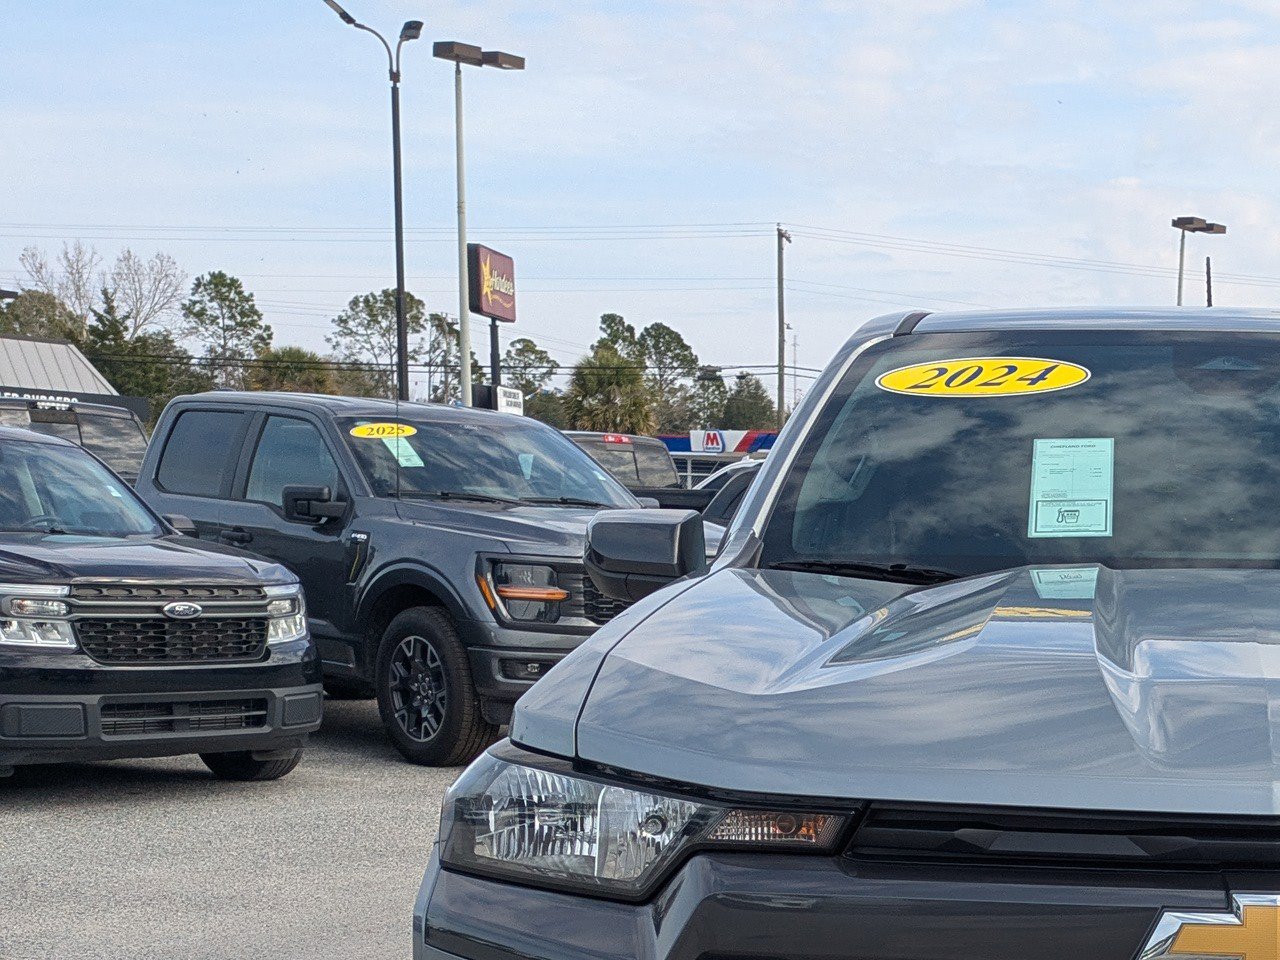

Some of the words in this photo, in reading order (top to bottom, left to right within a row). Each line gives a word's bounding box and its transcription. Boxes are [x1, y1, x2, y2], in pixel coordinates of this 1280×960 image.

[904, 364, 1061, 390] 2024
[366, 426, 406, 436] 2025
[705, 432, 720, 446] M
[173, 605, 195, 615] Ford
